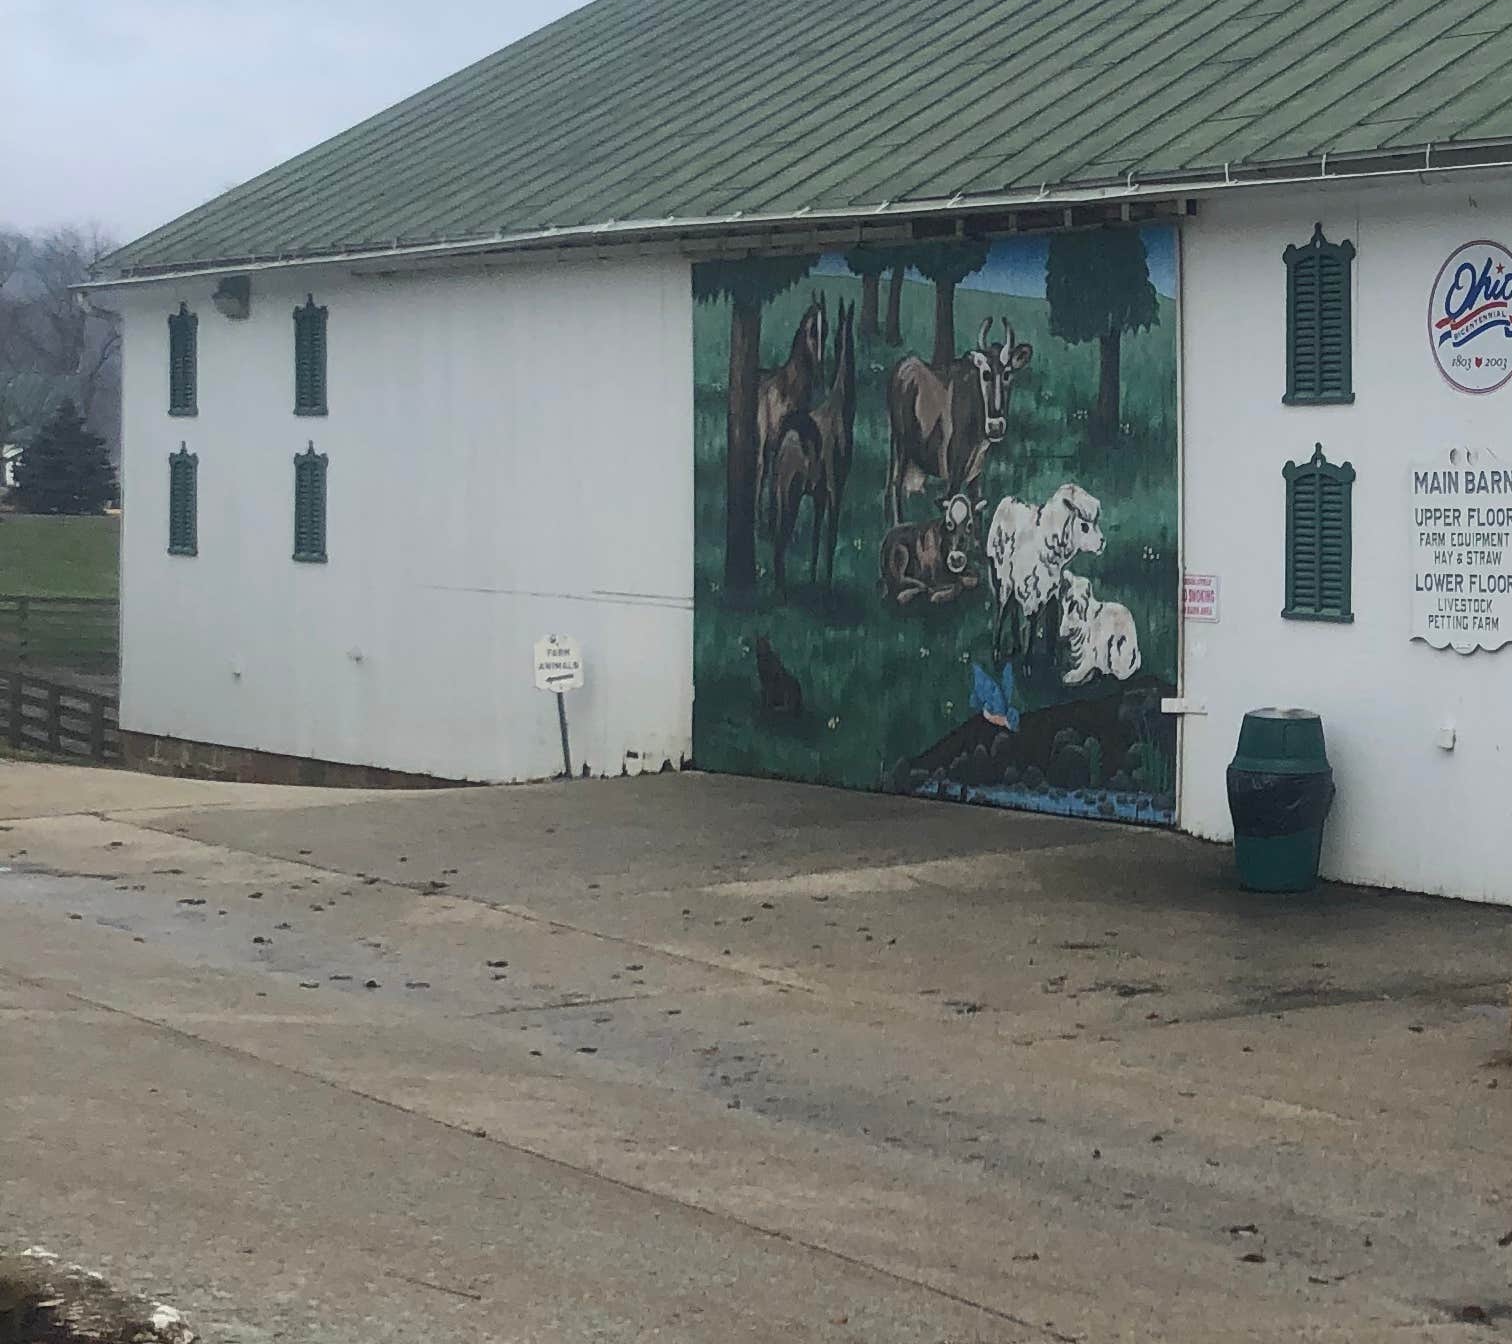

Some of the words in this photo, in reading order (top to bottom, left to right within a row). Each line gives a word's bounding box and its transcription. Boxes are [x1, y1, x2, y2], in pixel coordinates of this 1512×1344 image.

[1454, 310, 1507, 341] BICENTENNIAL
[1451, 354, 1472, 371] 1803
[1484, 357, 1508, 371] 2003
[1413, 470, 1459, 495] MAIN
[1414, 507, 1461, 527] UPPER
[1419, 532, 1446, 547] FARM
[1450, 532, 1510, 548] EQUIPMENT
[1434, 550, 1454, 565] HAY
[1456, 552, 1463, 565] &
[1466, 550, 1503, 565] STRAW
[1415, 573, 1464, 593] LOWER
[1437, 598, 1493, 613] LIVESTOCK
[1428, 614, 1469, 631] PETTING
[1472, 616, 1500, 632] FARM
[538, 660, 579, 670] ANIMALS
